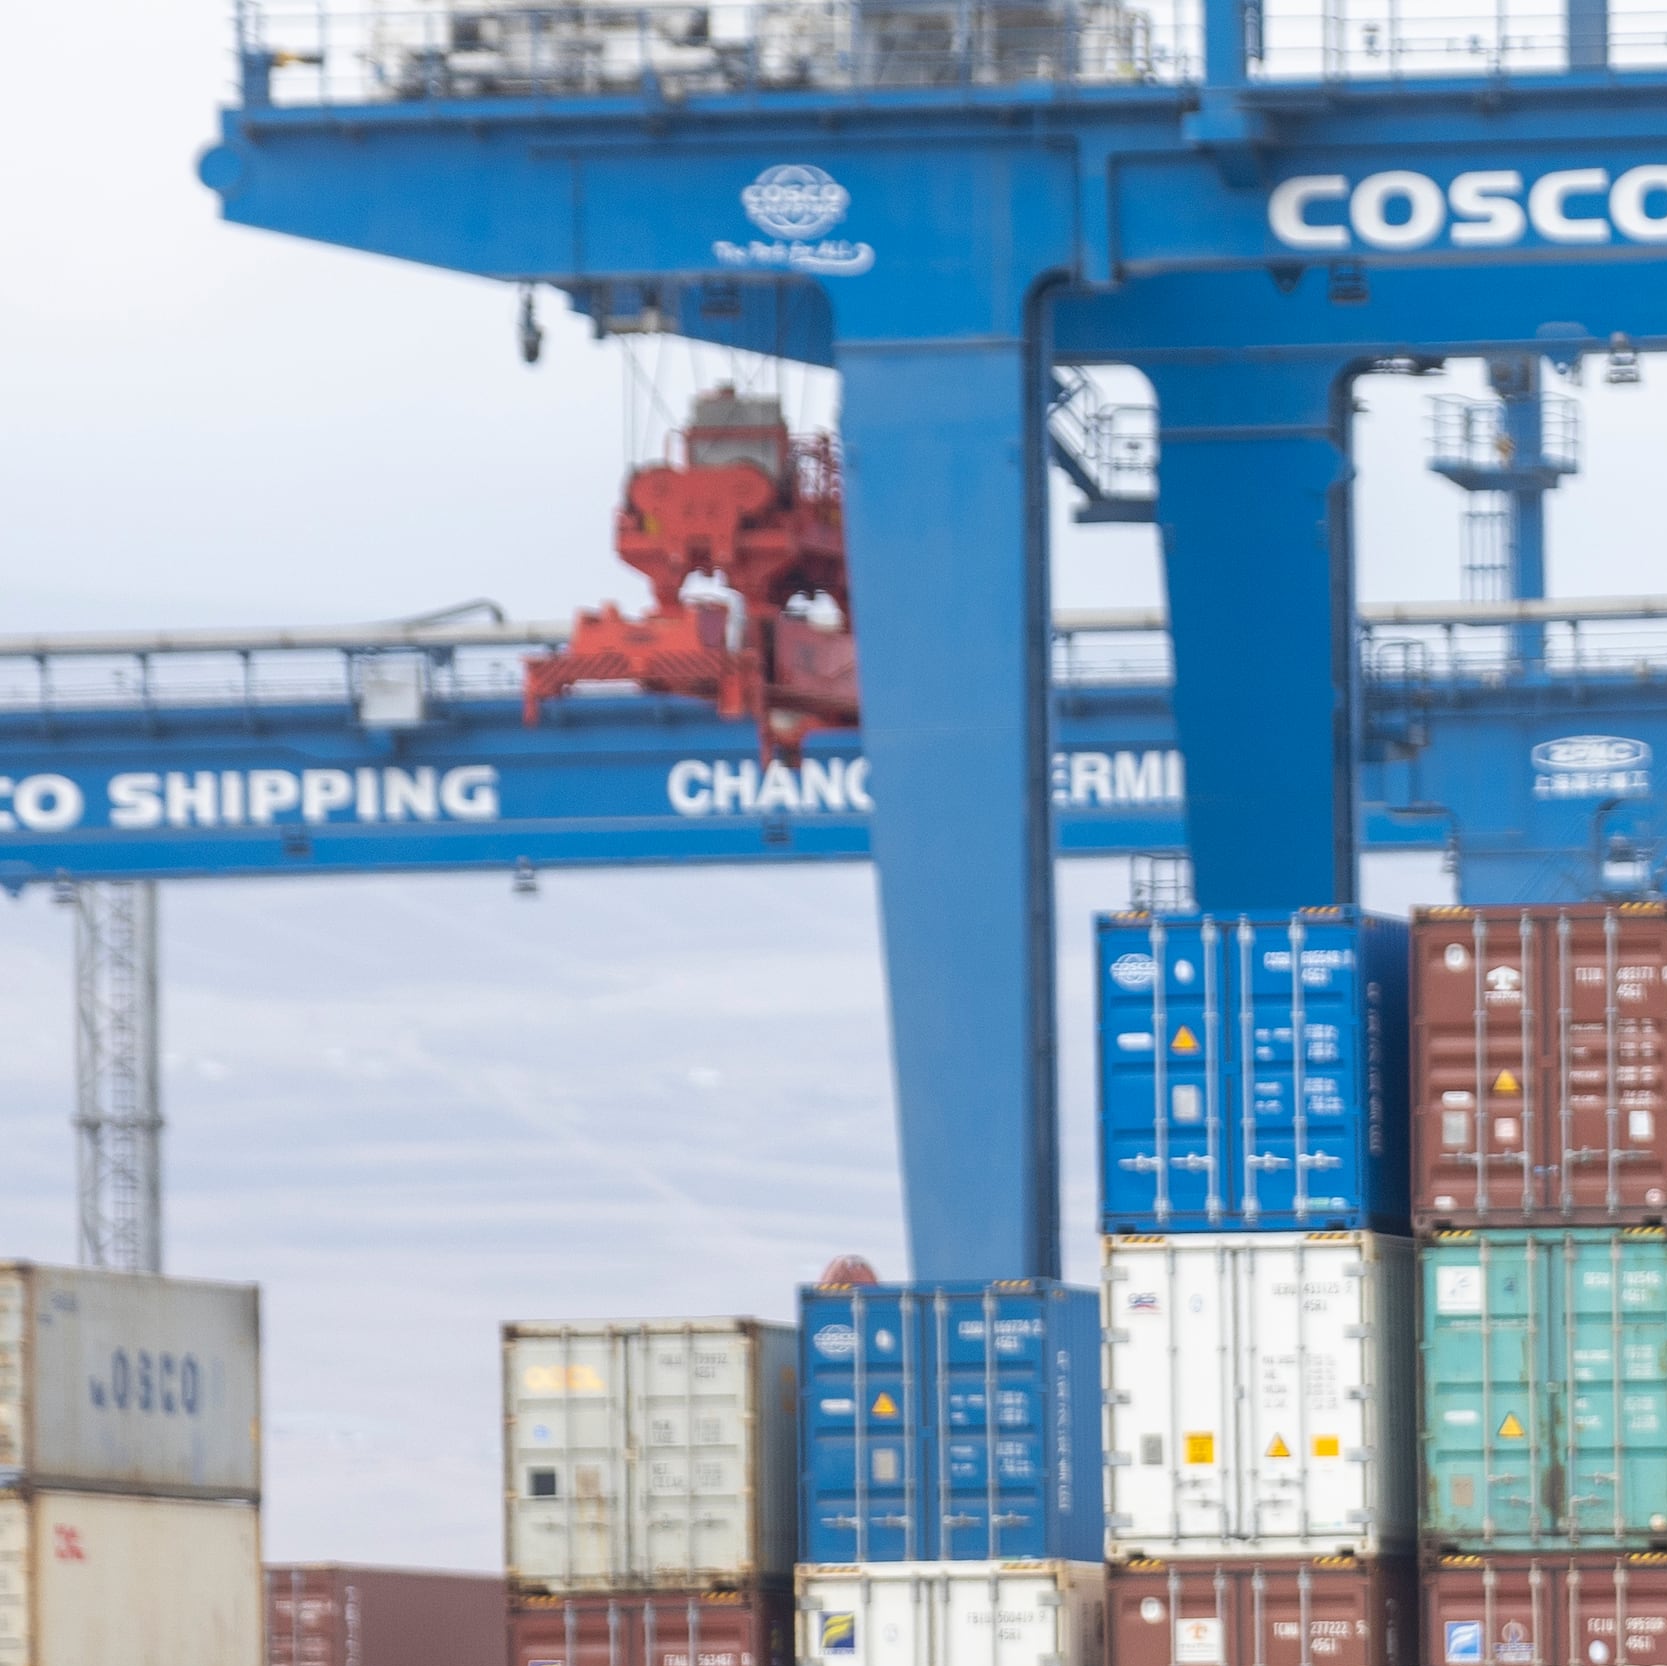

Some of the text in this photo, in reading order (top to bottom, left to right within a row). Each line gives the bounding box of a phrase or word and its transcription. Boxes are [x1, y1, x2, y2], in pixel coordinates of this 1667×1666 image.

[106, 763, 500, 831] SHIPPING
[666, 749, 1186, 818] CHANC ERMI
